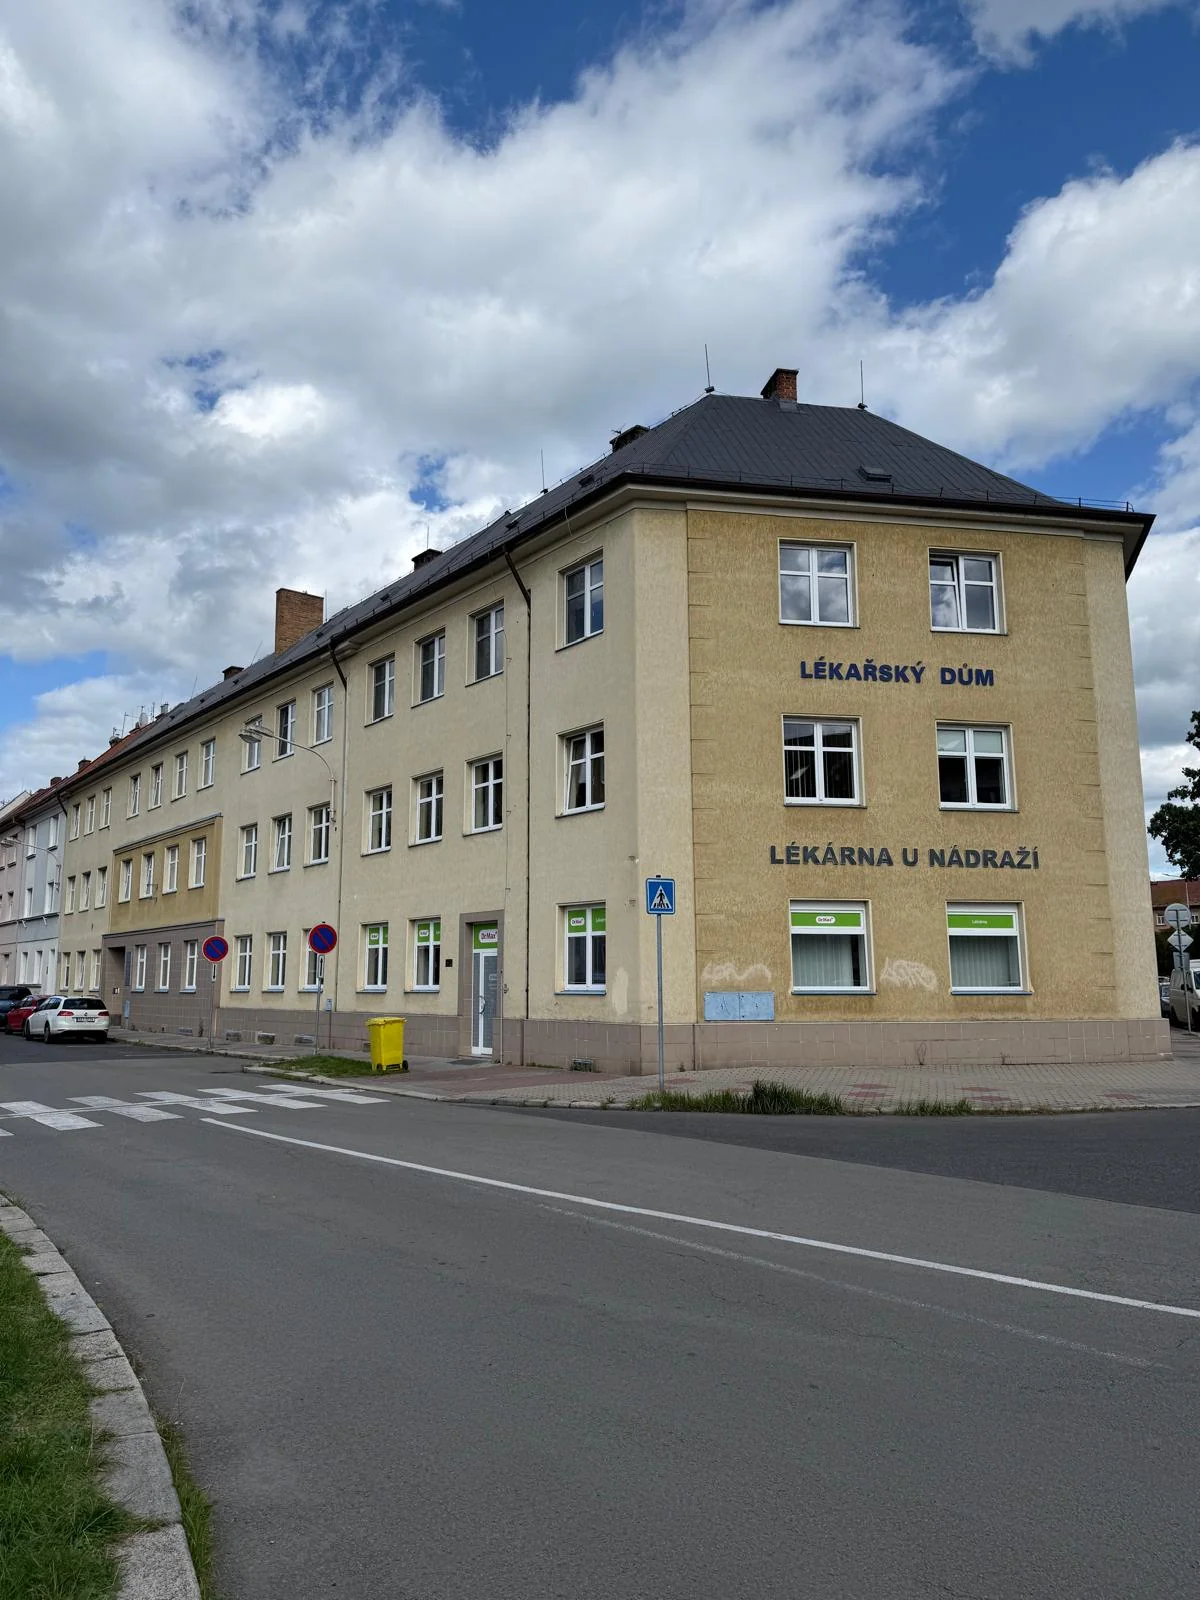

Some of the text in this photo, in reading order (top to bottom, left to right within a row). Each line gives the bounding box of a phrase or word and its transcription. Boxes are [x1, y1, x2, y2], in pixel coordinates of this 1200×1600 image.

[800, 656, 995, 686] LÉKAŘSKÝ DŮM
[770, 842, 1040, 870] LÉKÁRNA U NÁDRAŽÍ
